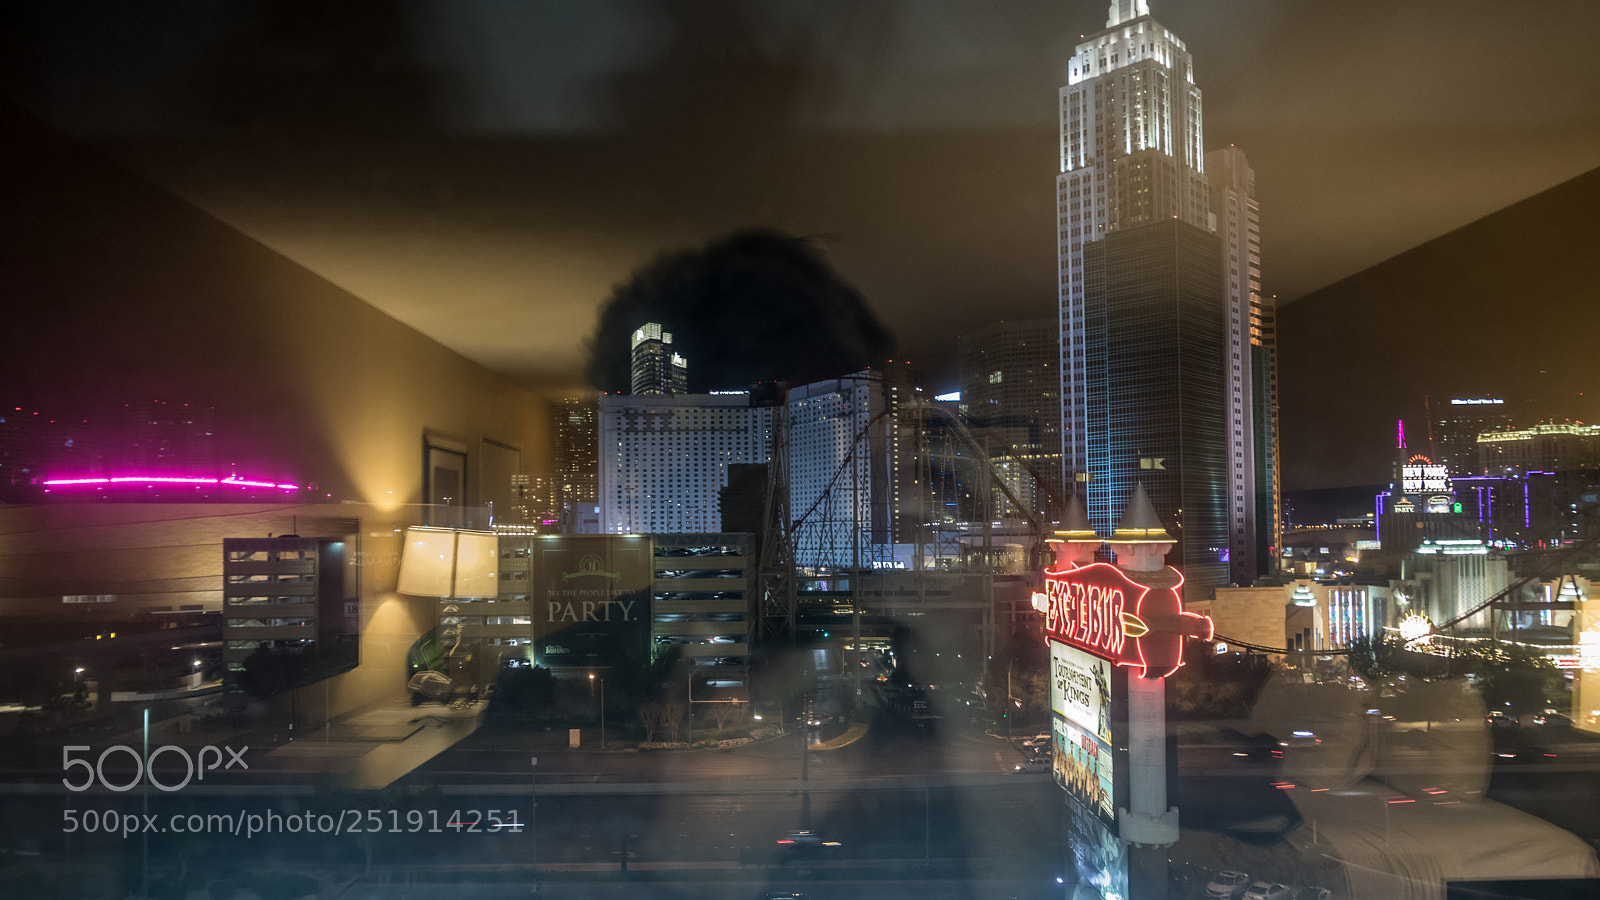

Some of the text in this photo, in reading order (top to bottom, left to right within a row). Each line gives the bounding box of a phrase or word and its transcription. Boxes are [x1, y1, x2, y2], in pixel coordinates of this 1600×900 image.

[546, 600, 638, 623] PARTY.
[1045, 578, 1125, 655] EXCALIBUR
[1053, 656, 1092, 691] TOURNAMENT
[1062, 680, 1090, 708] KINGS
